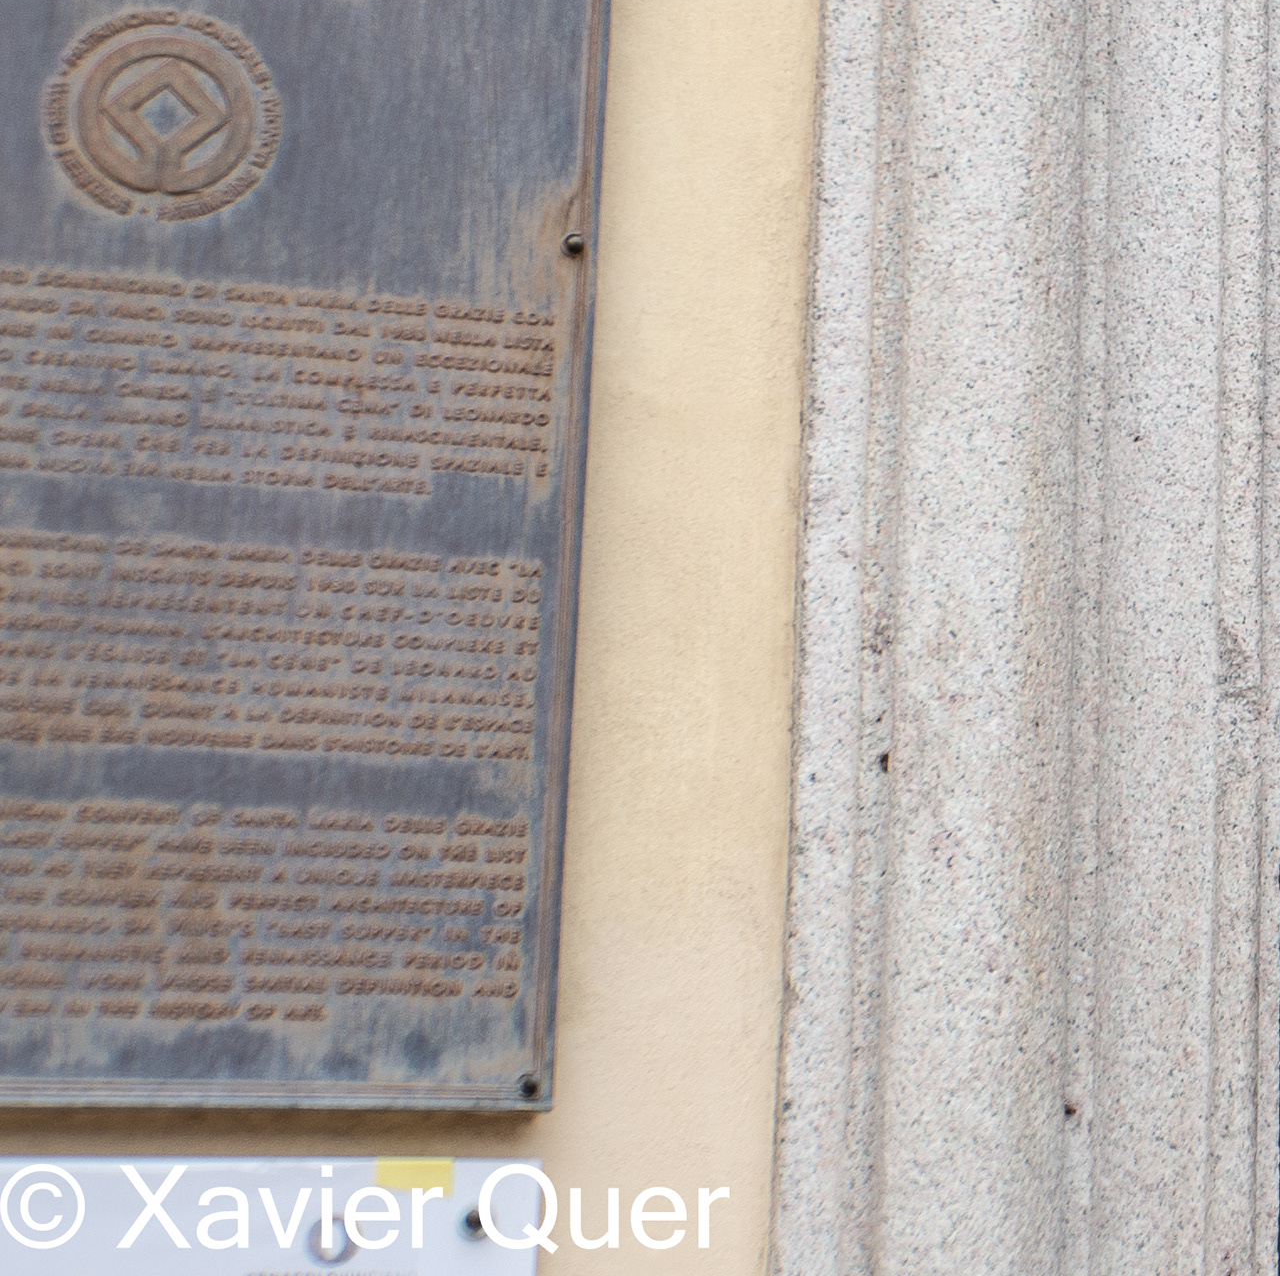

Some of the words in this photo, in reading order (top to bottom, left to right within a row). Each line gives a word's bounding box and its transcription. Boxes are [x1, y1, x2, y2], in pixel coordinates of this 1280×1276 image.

[511, 307, 555, 327] CON
[412, 351, 554, 378] ECCEZIONALE
[450, 379, 553, 404] PERFETTA
[440, 404, 552, 429] LEONARDO
[428, 453, 525, 476] SPAZIALE
[533, 460, 550, 477] E
[446, 556, 501, 575] AVEC
[445, 582, 504, 602] LISTE
[391, 631, 506, 654] COMPLEXE
[512, 638, 540, 656] ET
[407, 714, 440, 732] DE
[443, 716, 536, 736] L'ESPACE
[438, 741, 471, 759] DE
[491, 900, 526, 917] OF
[478, 926, 524, 944] THE
[400, 952, 486, 971] PERIOD
[469, 980, 519, 998] AND
